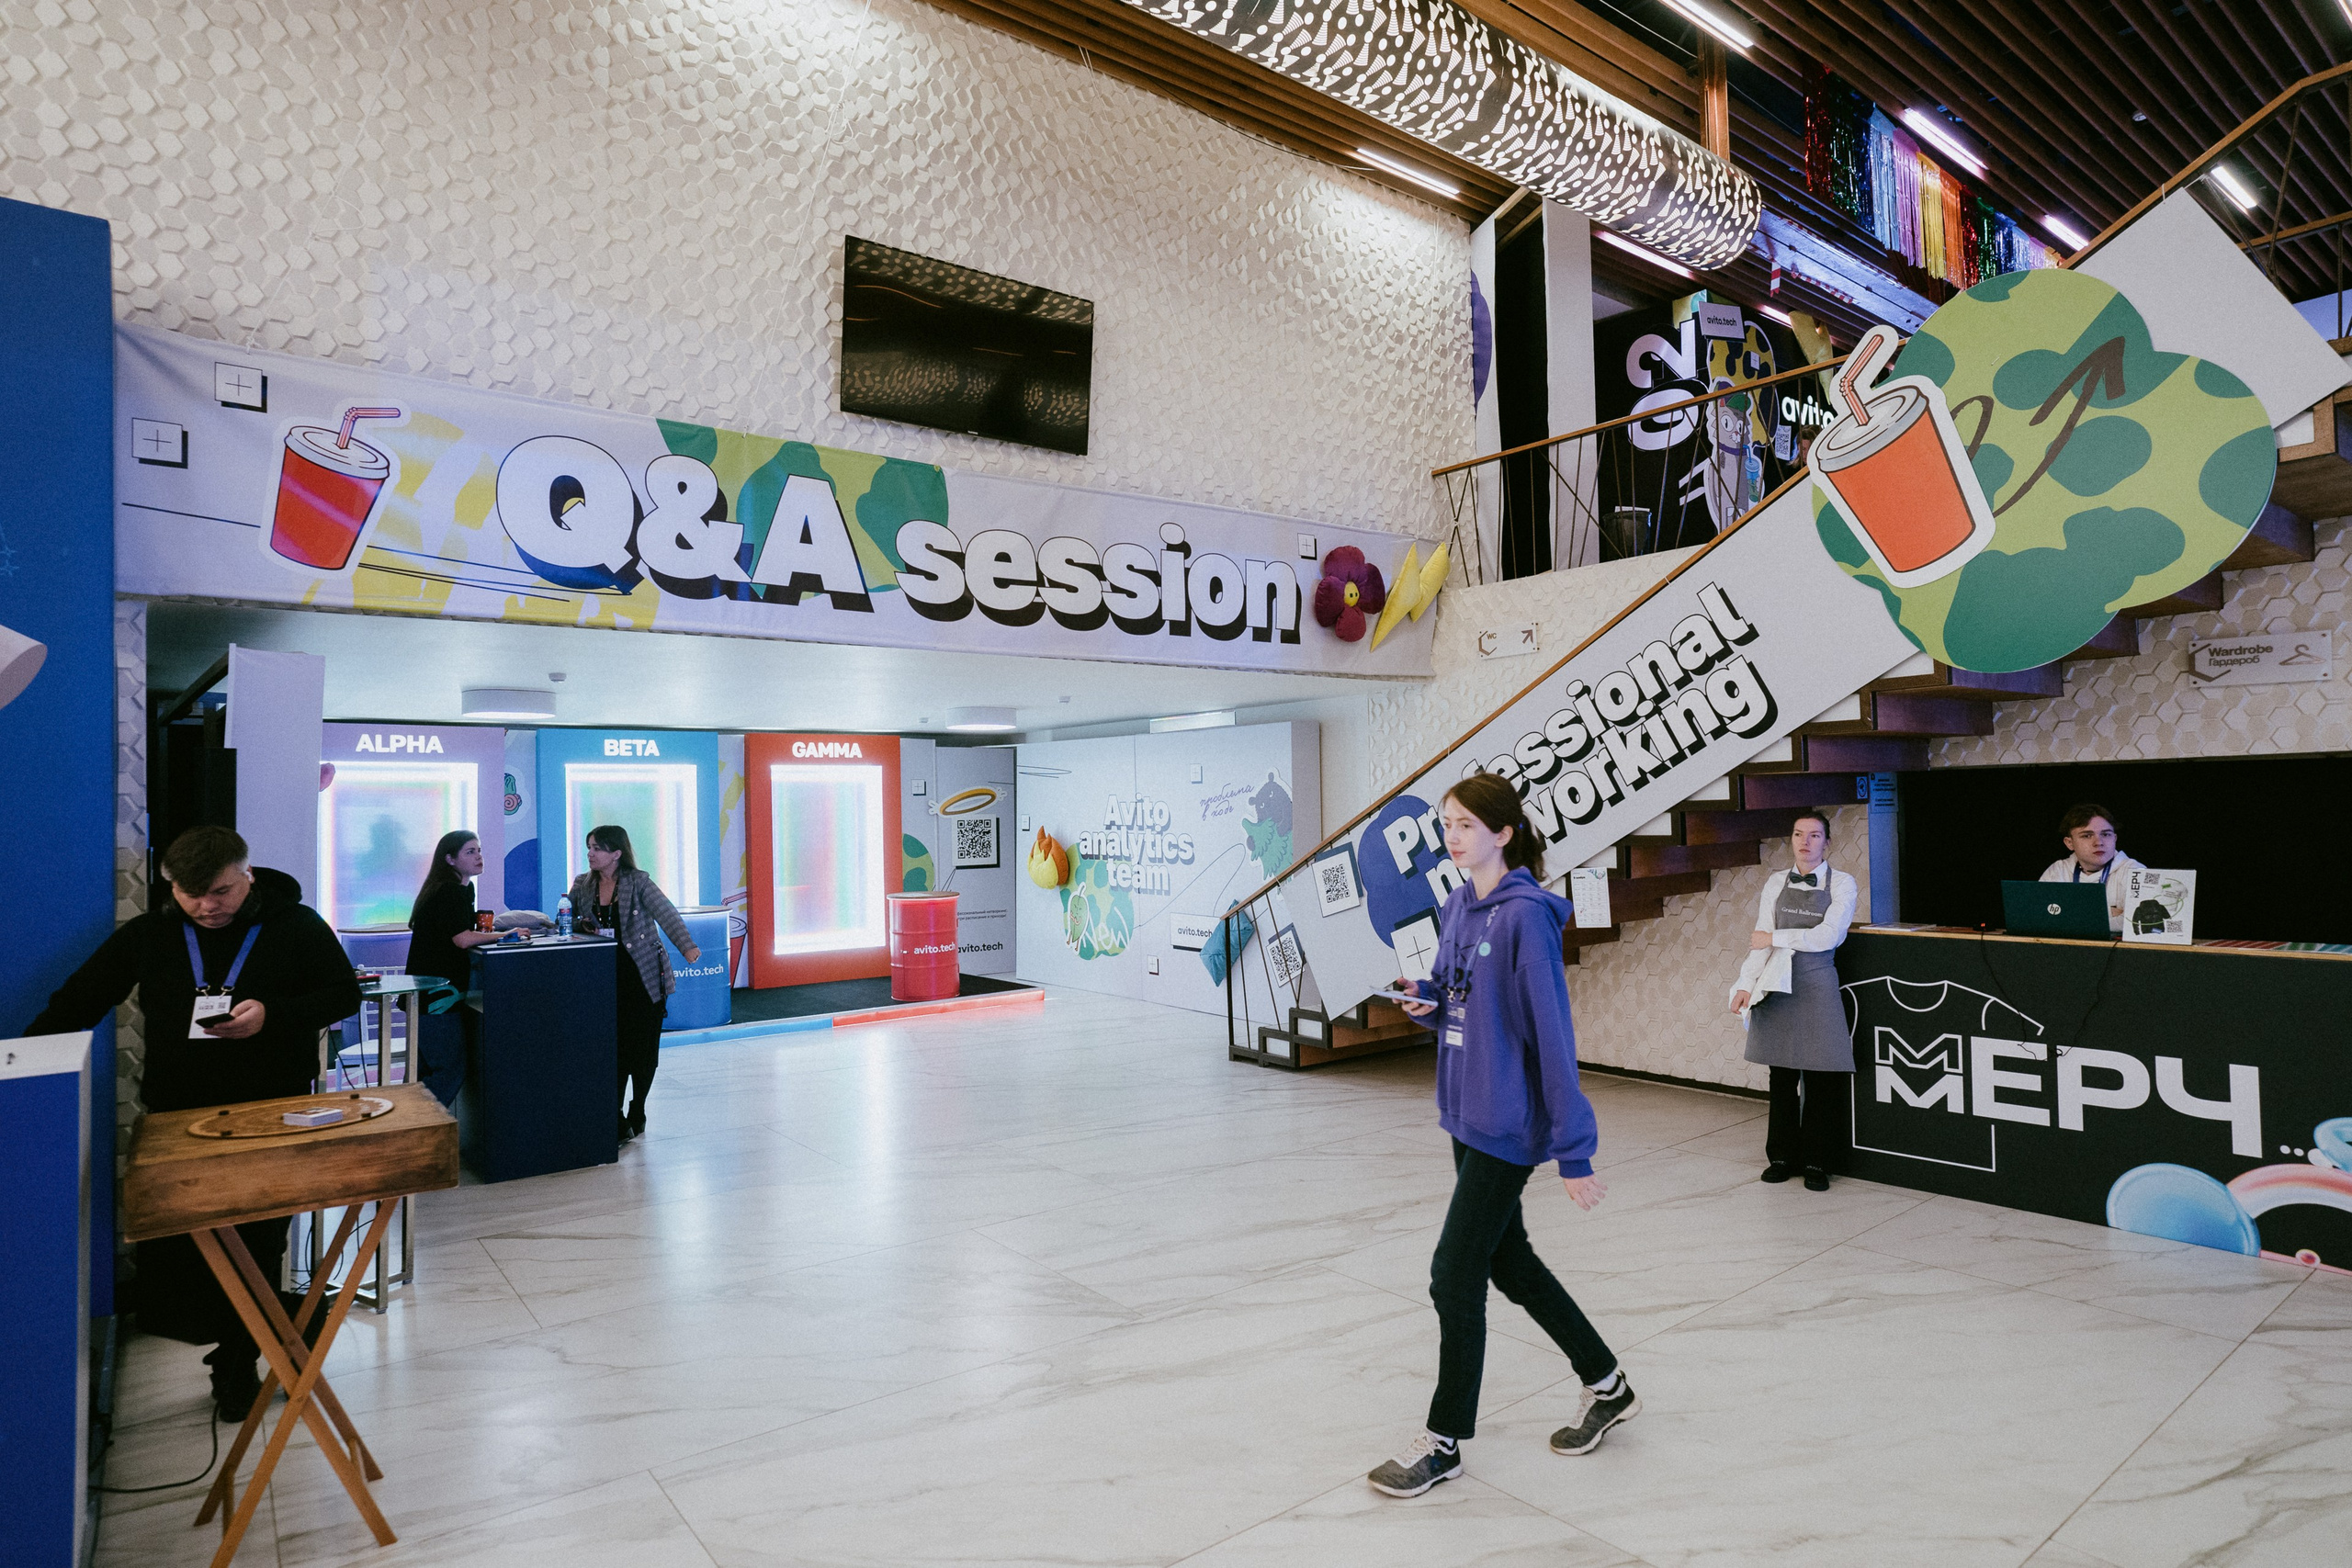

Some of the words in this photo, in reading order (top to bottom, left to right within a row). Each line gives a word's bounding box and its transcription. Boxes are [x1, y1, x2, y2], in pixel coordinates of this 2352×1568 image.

[1706, 315, 1737, 327] avito.tech
[496, 435, 874, 613] Q&A
[894, 520, 1302, 645] session
[1486, 632, 1498, 640] WC
[2209, 645, 2273, 657] Wardrobe
[2209, 656, 2259, 667] Гардероб
[1382, 581, 1759, 879] Pressional
[355, 732, 445, 754] ALPHA
[603, 739, 661, 757] BETA
[791, 740, 863, 760] GAMMA
[1103, 793, 1171, 831] Avito
[1079, 825, 1195, 865] analytics
[1105, 857, 1171, 897] team
[2049, 903, 2060, 916] hp
[1177, 925, 1213, 938] avito.tech
[913, 942, 956, 954] avito.tech
[673, 964, 724, 978] avito.tech
